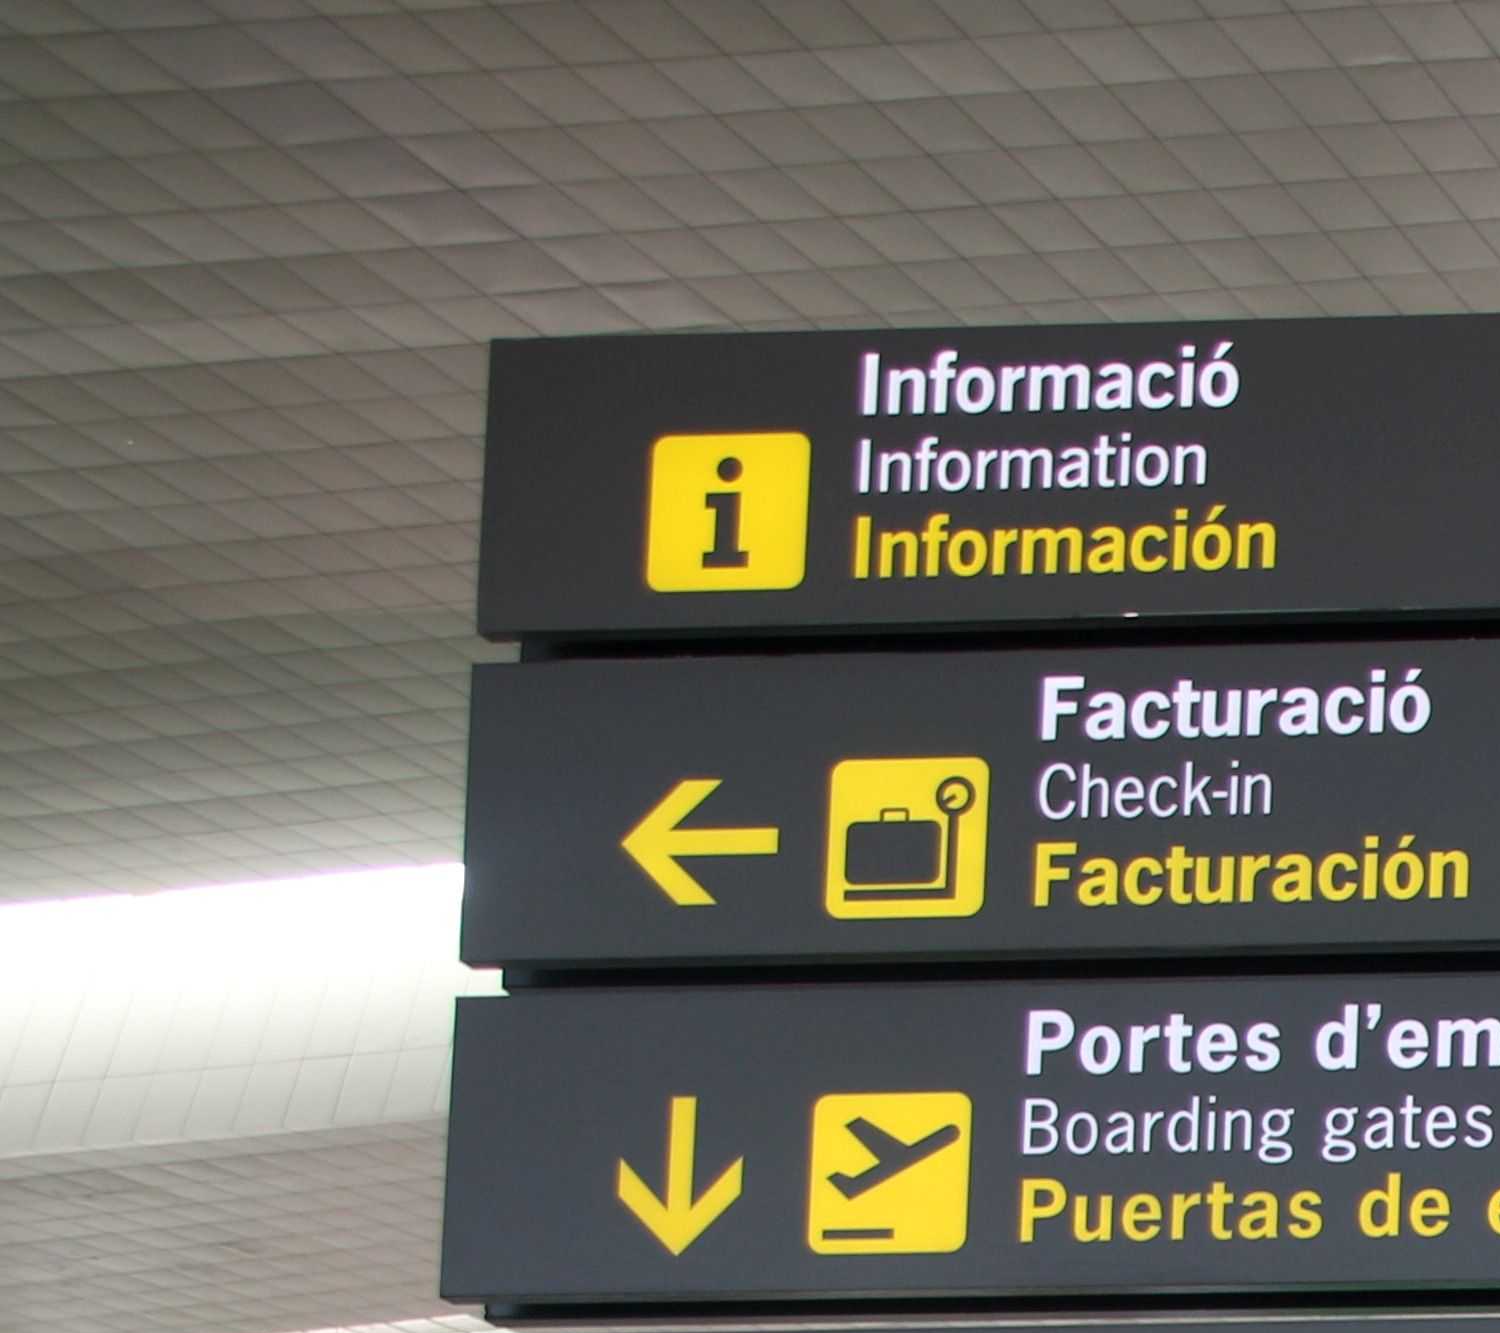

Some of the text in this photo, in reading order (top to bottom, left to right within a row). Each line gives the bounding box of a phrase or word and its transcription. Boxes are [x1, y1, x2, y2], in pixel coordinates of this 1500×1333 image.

[861, 341, 1238, 415] Informació
[857, 431, 1206, 492] Information
[854, 501, 1275, 578] Información
[1040, 668, 1430, 740] Facturació
[1038, 760, 1271, 819] Check-in
[1034, 835, 1468, 906] Facturación
[1024, 1010, 1280, 1075] Portes
[1021, 1095, 1492, 1163] Boarding gates
[1019, 1178, 1322, 1242] Puertas
[1358, 1171, 1450, 1237] de
